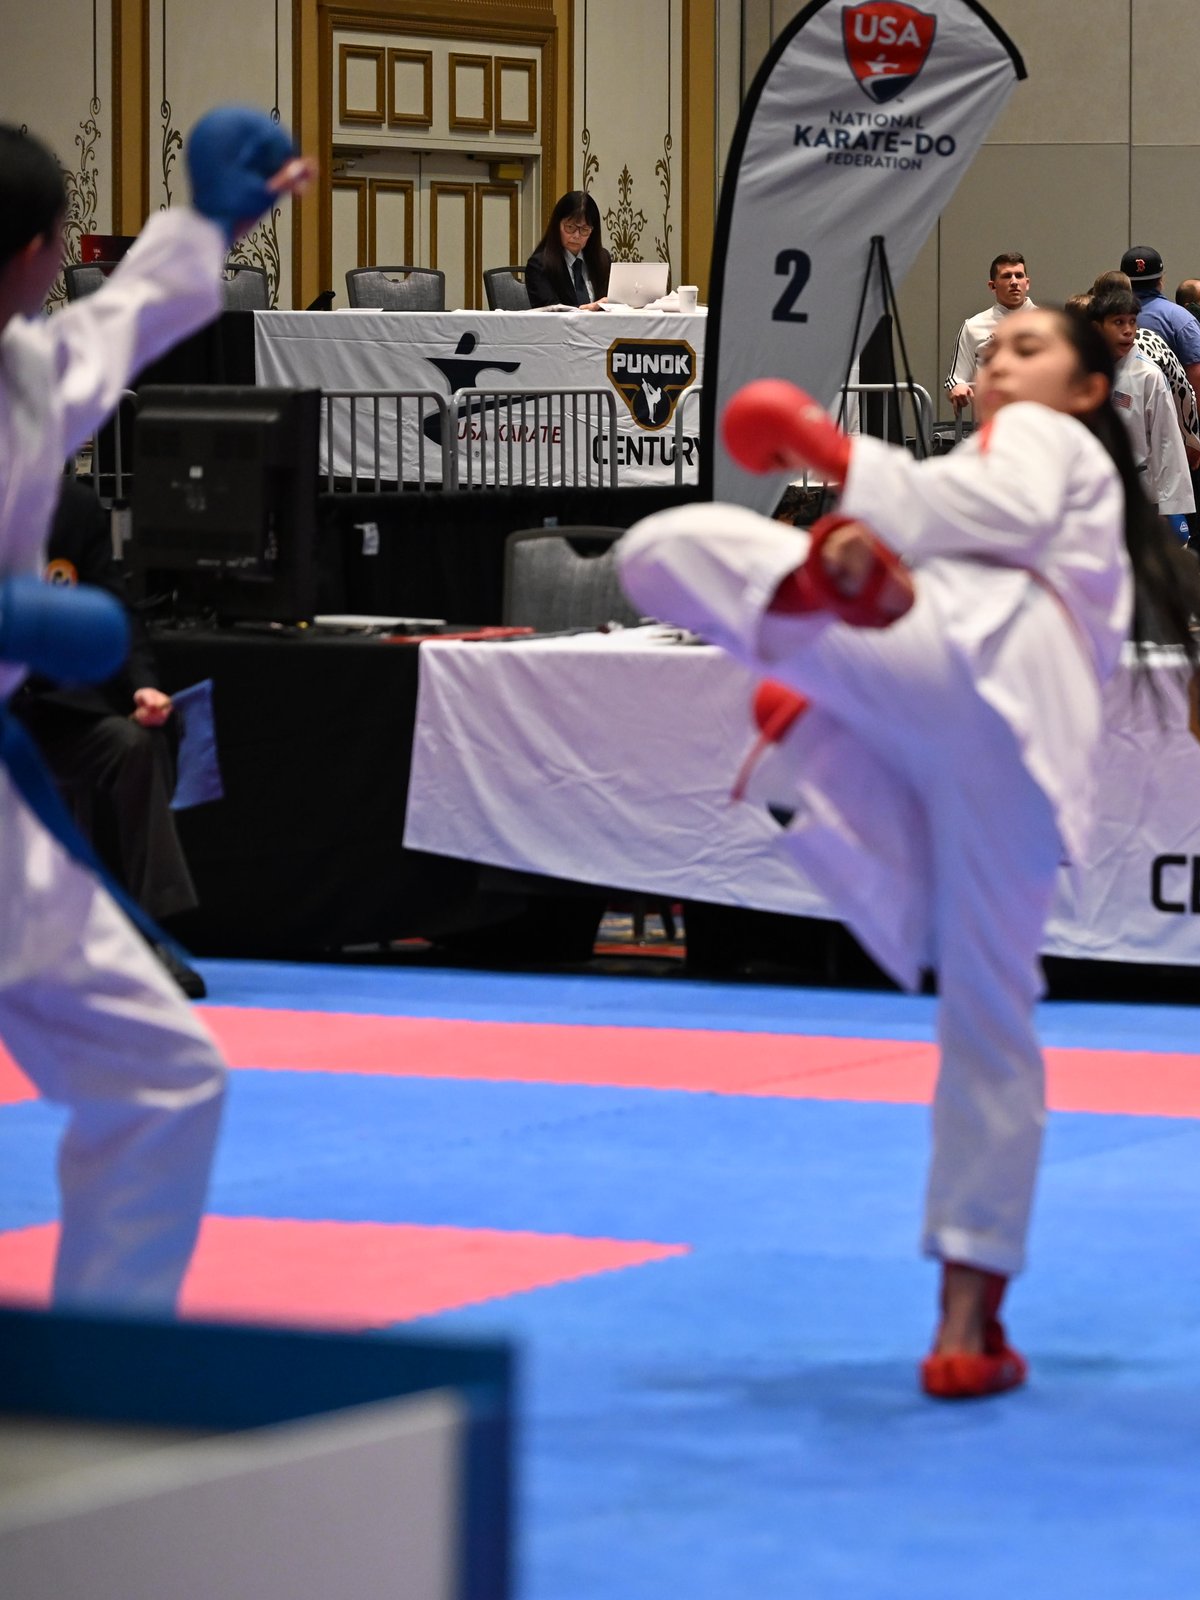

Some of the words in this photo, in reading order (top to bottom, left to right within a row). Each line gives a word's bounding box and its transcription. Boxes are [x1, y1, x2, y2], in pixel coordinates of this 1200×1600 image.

[854, 14, 921, 48] USA
[829, 110, 924, 130] NATIONAL
[793, 124, 956, 157] KARATE-DO
[825, 151, 923, 171] FEDERATION
[771, 248, 811, 323] 2
[612, 352, 690, 375] PUNOK
